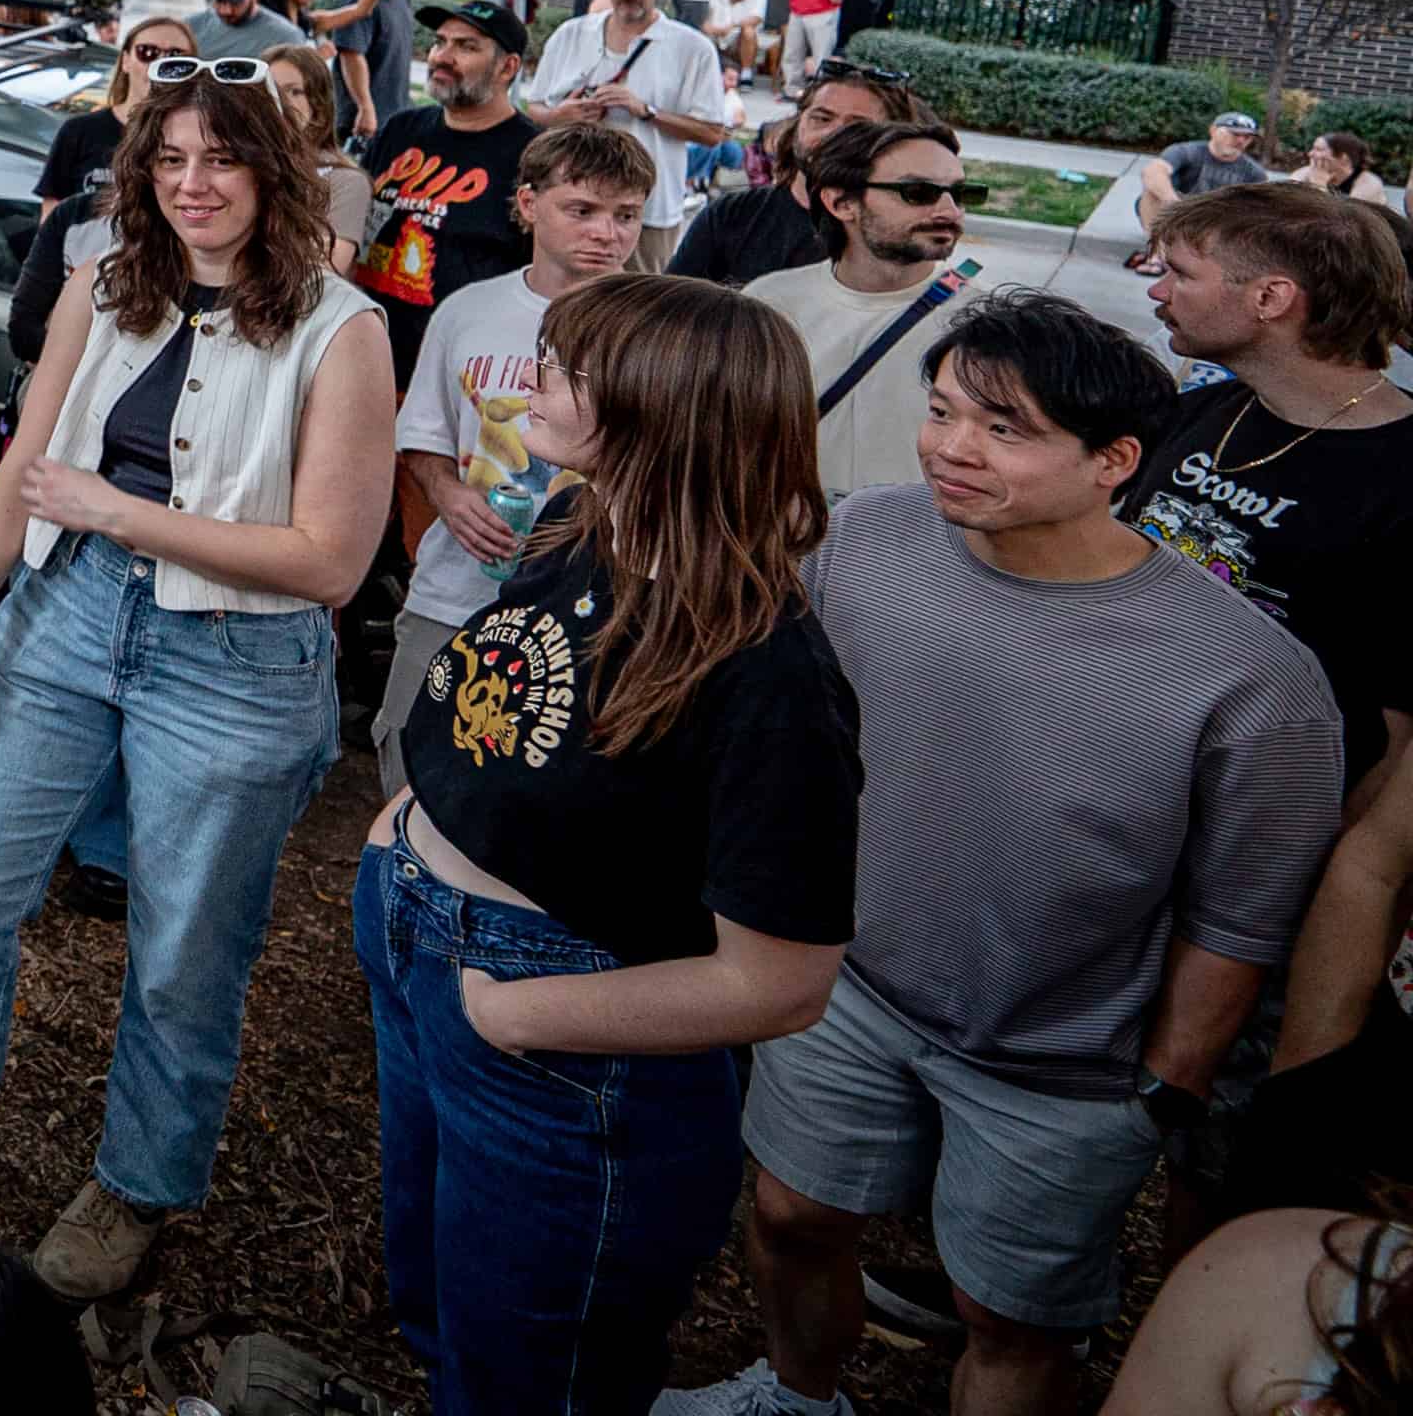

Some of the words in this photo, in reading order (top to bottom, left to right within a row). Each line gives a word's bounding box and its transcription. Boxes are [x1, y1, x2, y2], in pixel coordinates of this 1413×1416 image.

[373, 146, 490, 215] PUP
[461, 355, 493, 392] FOO
[475, 626, 521, 646] WATER
[518, 635, 546, 681] BASED
[521, 685, 544, 715] INK
[522, 612, 575, 768] PRINTSHOP
